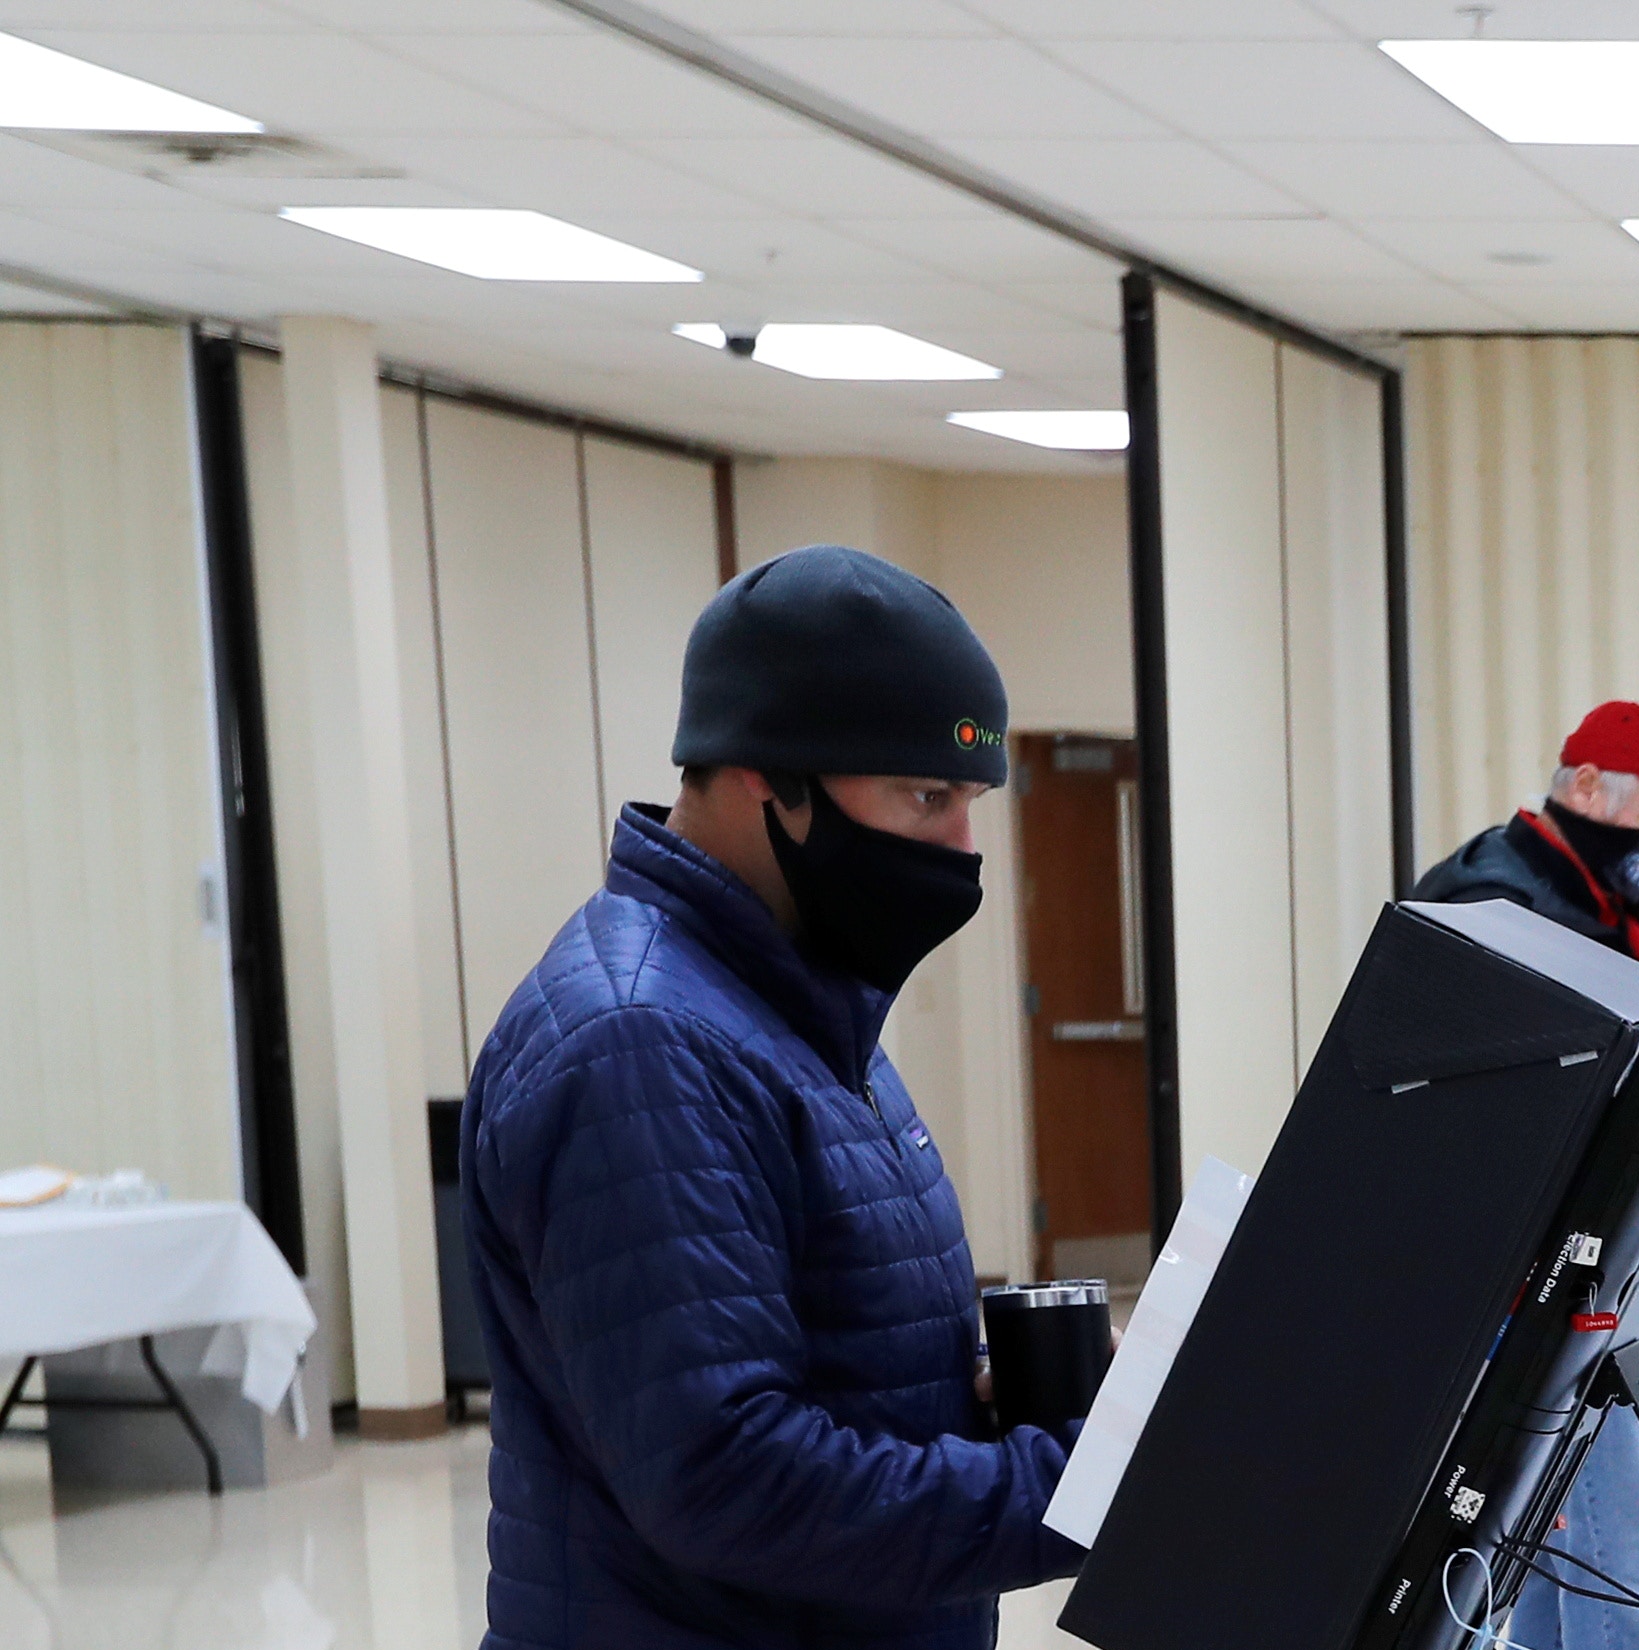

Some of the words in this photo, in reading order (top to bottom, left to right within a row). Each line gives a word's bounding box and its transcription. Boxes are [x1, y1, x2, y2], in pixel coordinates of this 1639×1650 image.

[1537, 1277, 1557, 1303] Data
[1444, 1464, 1466, 1498] Power
[1388, 1578, 1411, 1614] Printer
